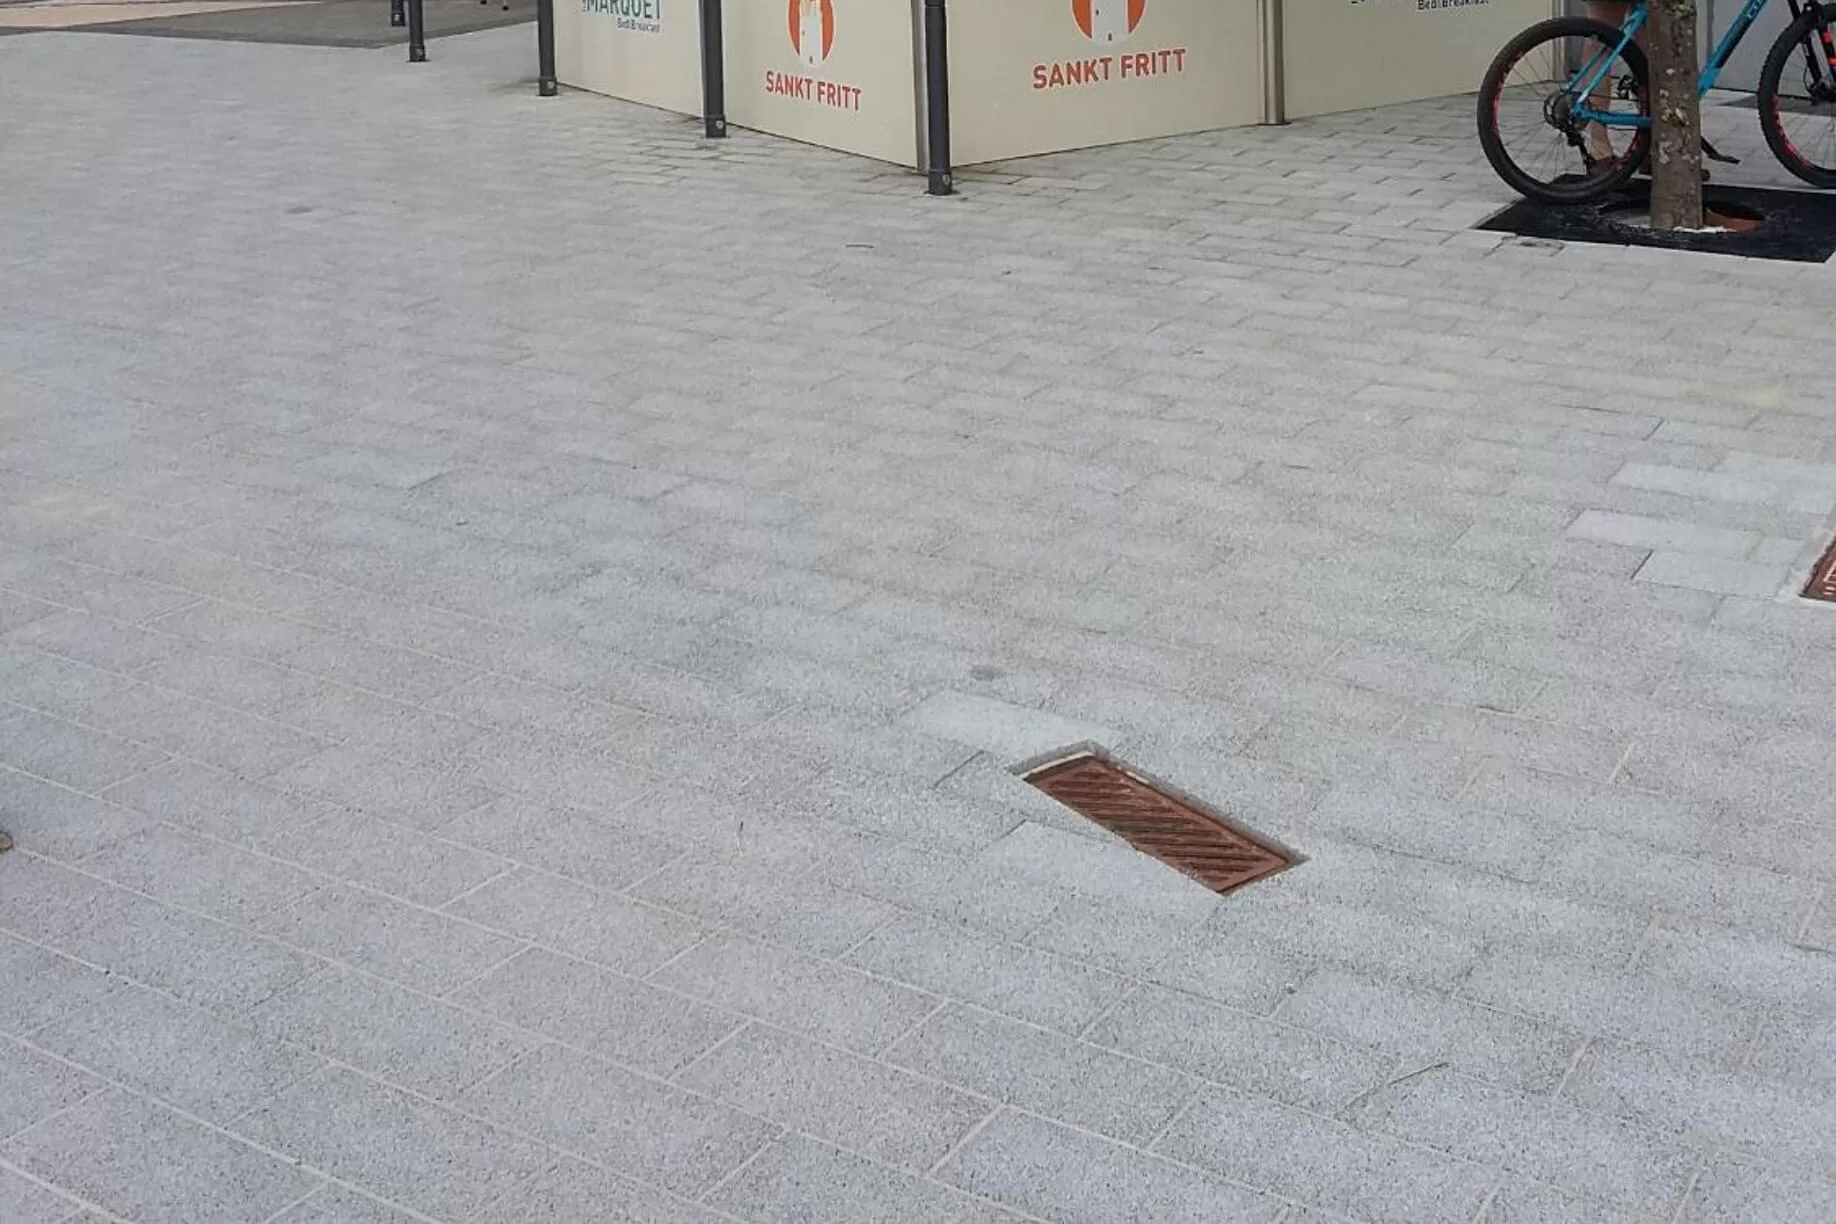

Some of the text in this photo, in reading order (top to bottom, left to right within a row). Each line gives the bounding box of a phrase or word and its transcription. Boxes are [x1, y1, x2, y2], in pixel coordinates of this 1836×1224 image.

[1032, 48, 1186, 90] SANKT FRITT
[766, 70, 862, 111] SANKT FRITT
